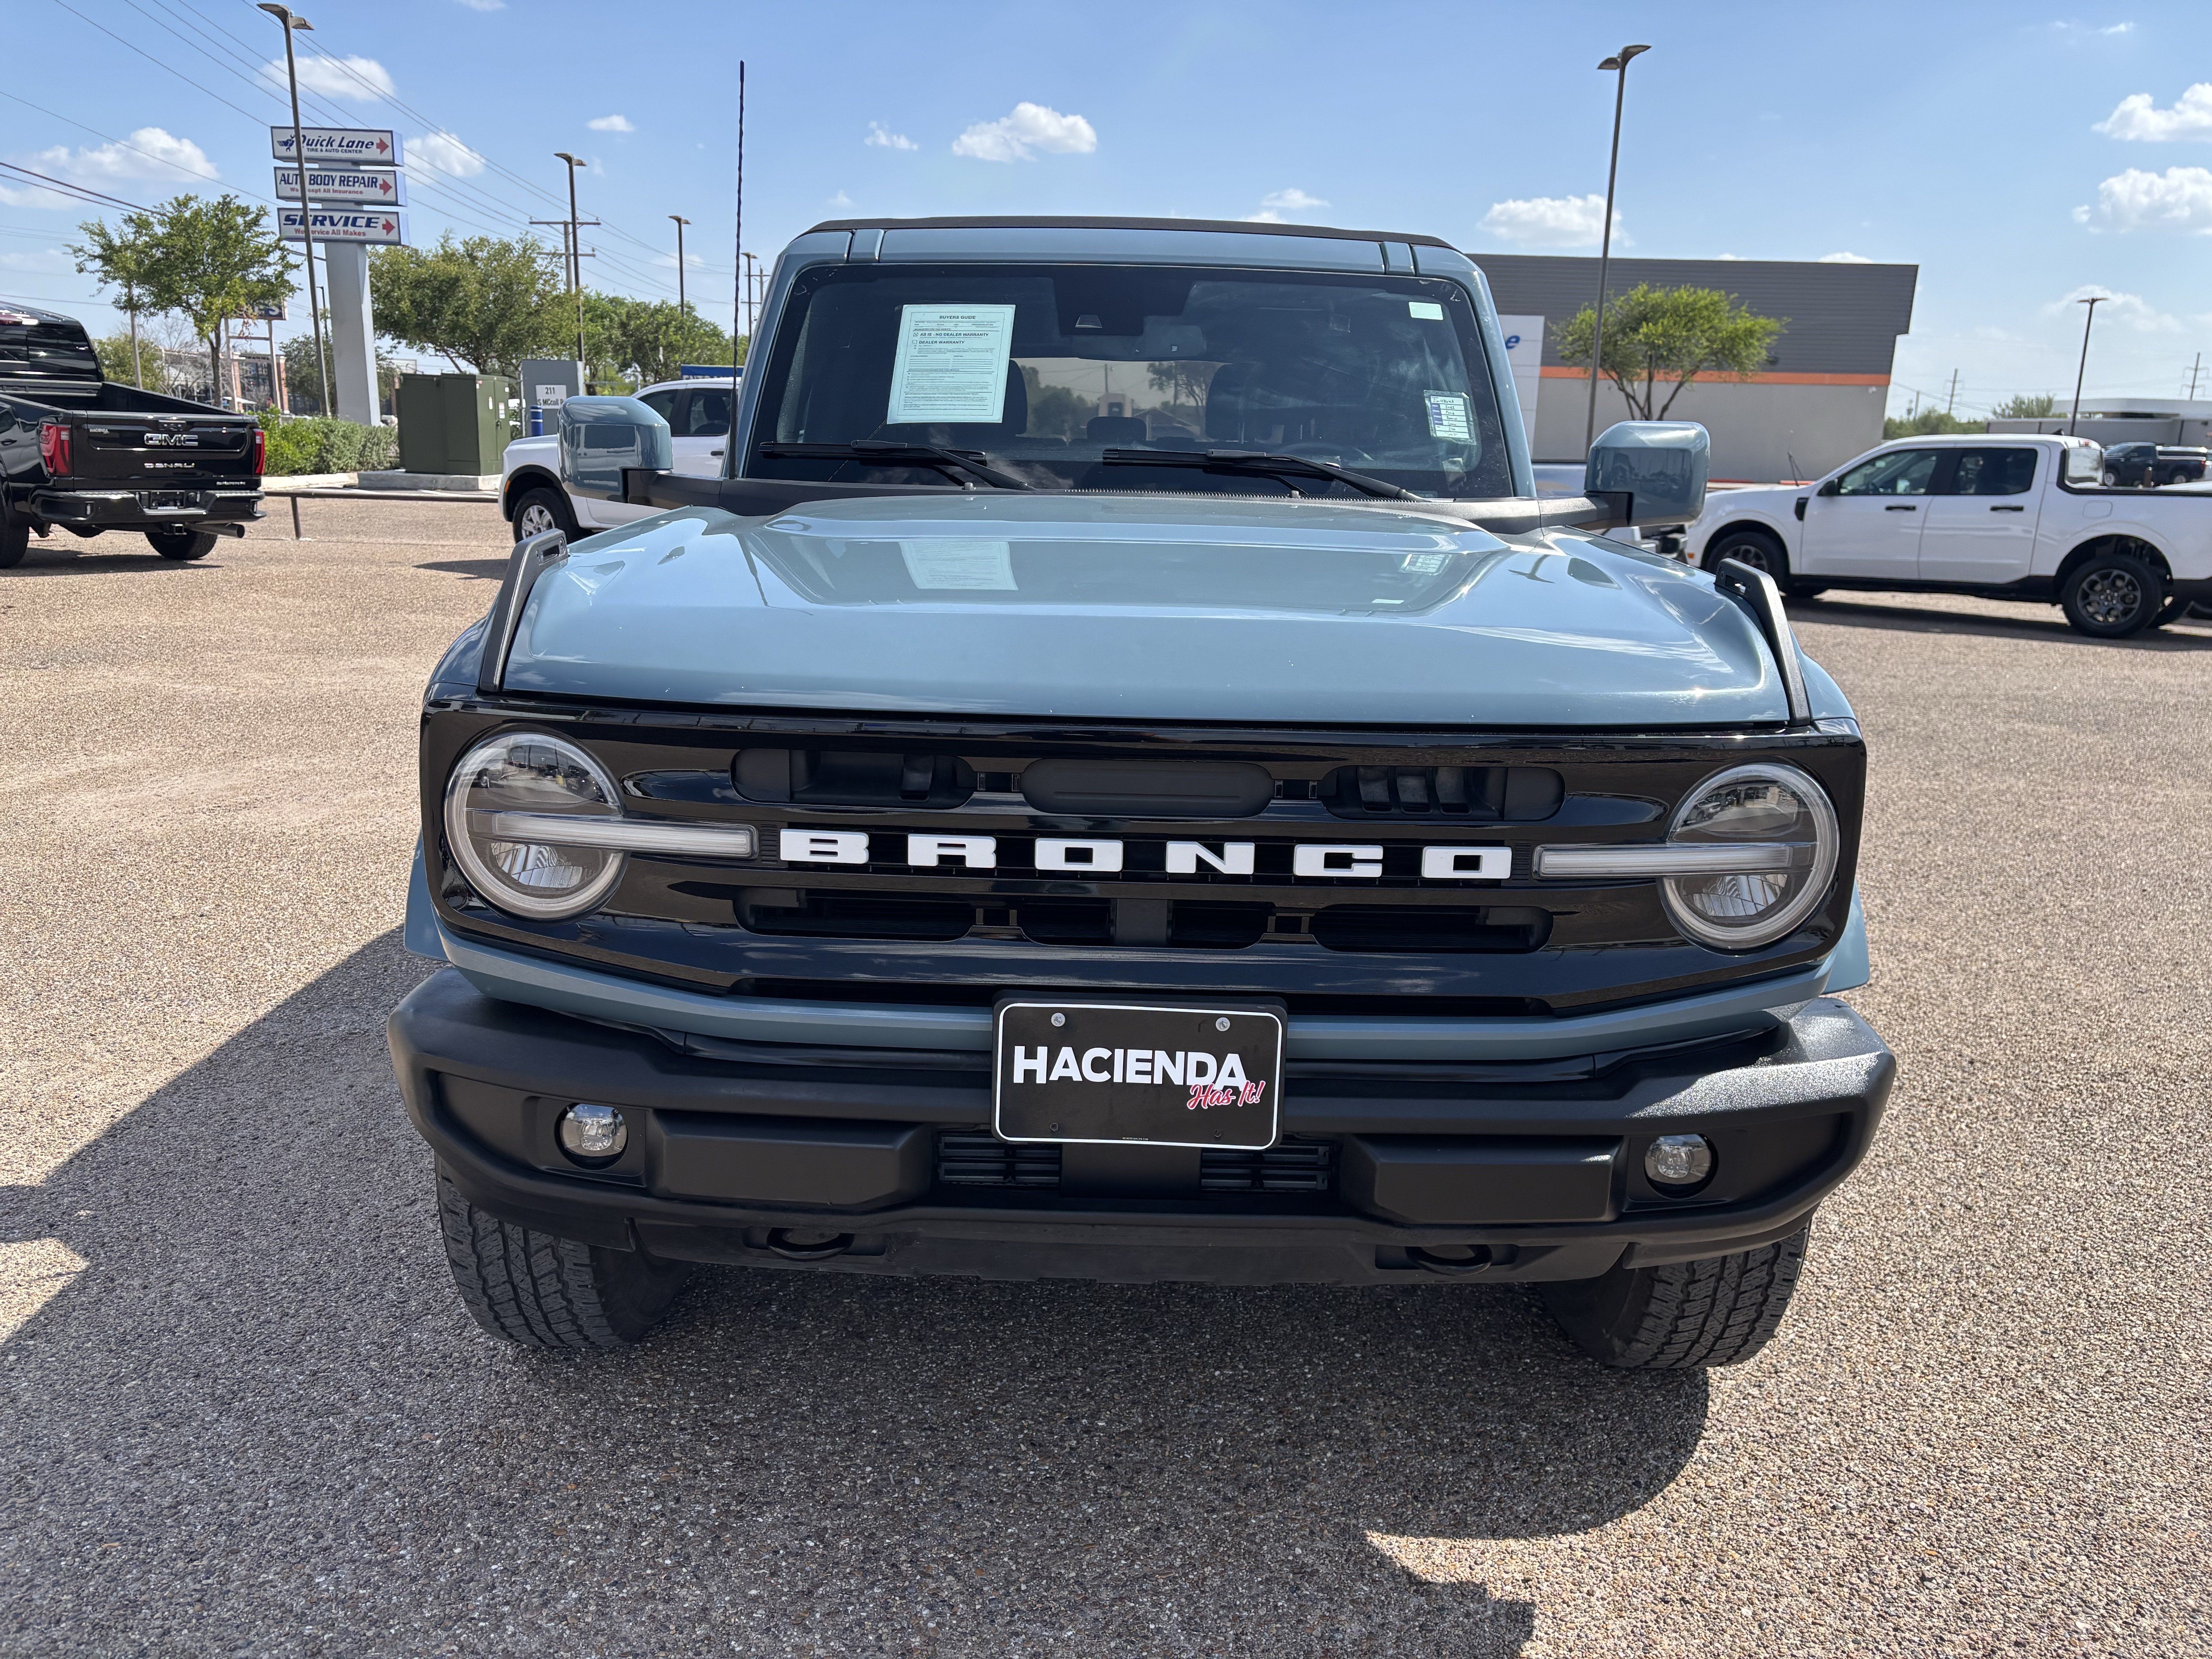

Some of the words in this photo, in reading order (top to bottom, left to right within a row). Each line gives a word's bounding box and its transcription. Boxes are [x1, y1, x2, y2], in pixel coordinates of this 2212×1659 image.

[338, 136, 374, 149] Lane
[279, 173, 300, 185] AUT
[309, 174, 337, 186] BODY
[338, 175, 378, 188] REPAIR
[144, 433, 198, 446] GMC
[780, 828, 1512, 879] BRONCO
[1013, 1045, 1246, 1091] HACIENDA
[1186, 1084, 1235, 1110] Has
[1237, 1080, 1266, 1106] It!
